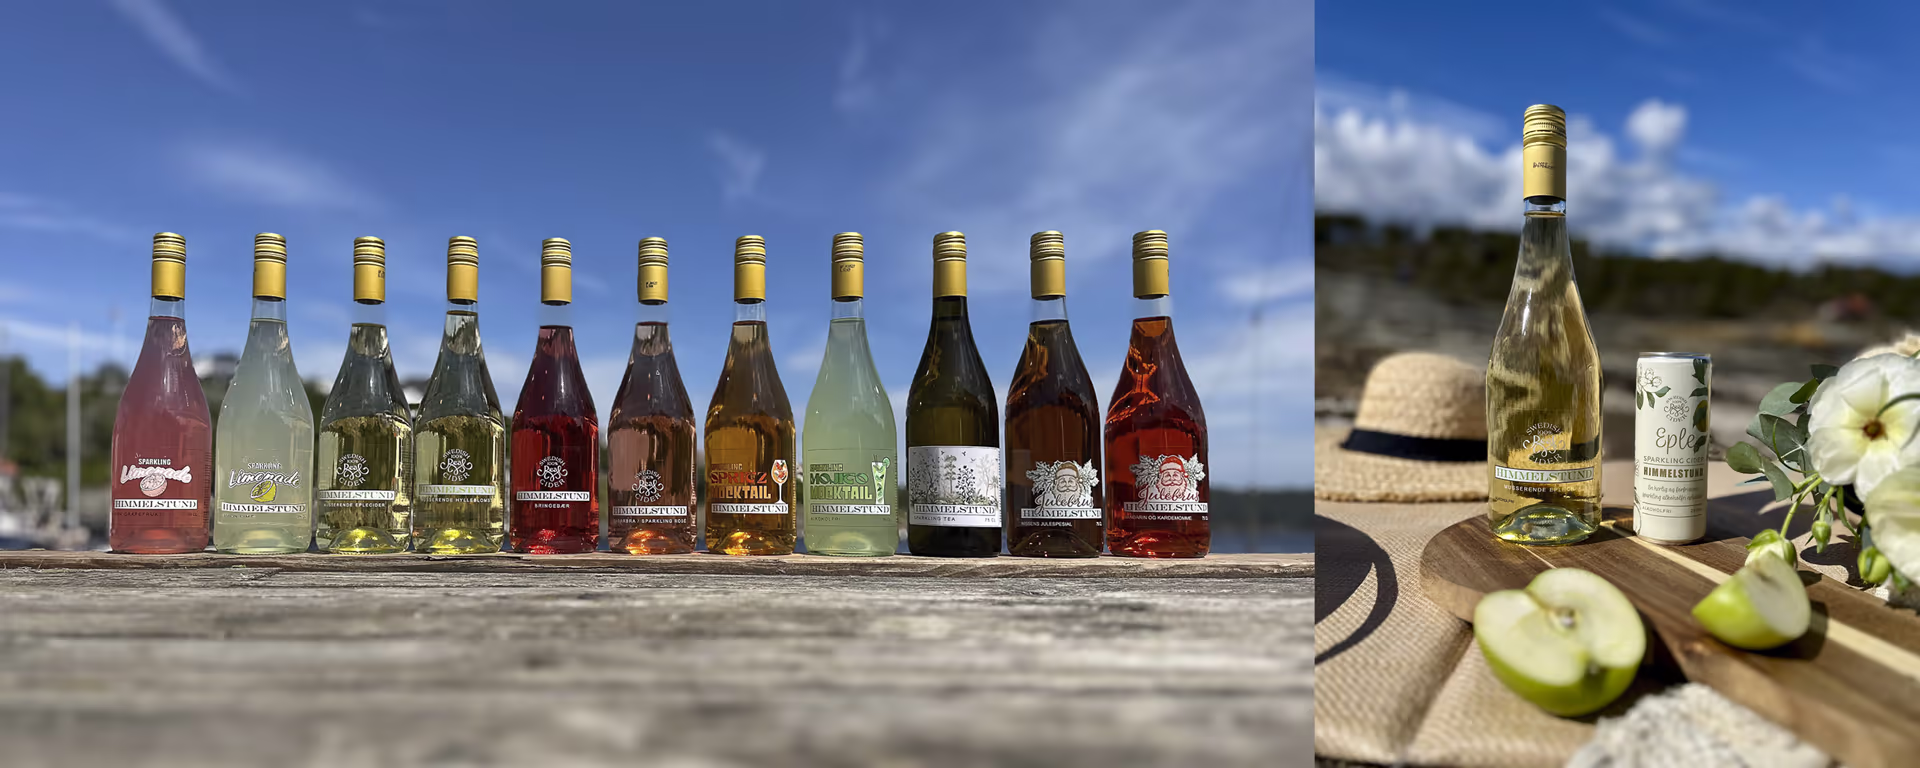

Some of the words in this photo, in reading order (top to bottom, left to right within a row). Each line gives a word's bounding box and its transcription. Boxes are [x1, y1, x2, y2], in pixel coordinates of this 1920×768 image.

[1665, 414, 1688, 422] CIDER
[1655, 427, 1696, 454] Eple
[338, 453, 367, 464] SWEDISH
[443, 448, 471, 459] SWEDISH
[138, 458, 171, 466] SPARKLING
[539, 456, 566, 466] SWEDISH
[1527, 453, 1562, 465] CIDER
[1643, 455, 1684, 464] SPARKLING
[1685, 456, 1704, 464] CIDER
[442, 471, 470, 482] CIDER
[634, 469, 662, 480] SWEDISH
[1496, 467, 1593, 481] HIMMELSTUND
[1643, 466, 1704, 478] HIMMELSTUND
[228, 469, 300, 488] Limonade
[338, 476, 367, 487] CIDER
[539, 478, 566, 488] CIDER
[810, 472, 869, 485] MOJITO
[420, 486, 495, 494] HIMMELSTUND
[810, 485, 873, 500] MOCKTAIL
[1504, 484, 1547, 493] MUSSERENDE
[320, 491, 394, 499] HIMMELSTUND
[517, 492, 589, 500] HIMMELSTUND
[635, 493, 662, 503] CIDER
[1035, 484, 1093, 514] Julebrus
[1138, 484, 1200, 508] Julebrus
[115, 500, 196, 508] HIMMELSTUND
[223, 503, 305, 512] HIMMELSTUND
[712, 504, 787, 512] HIMMELSTUND
[812, 505, 889, 513] HIMMELSTUND
[613, 507, 686, 515] HIMMELSTUND
[915, 505, 994, 514] HIMMELSTUND
